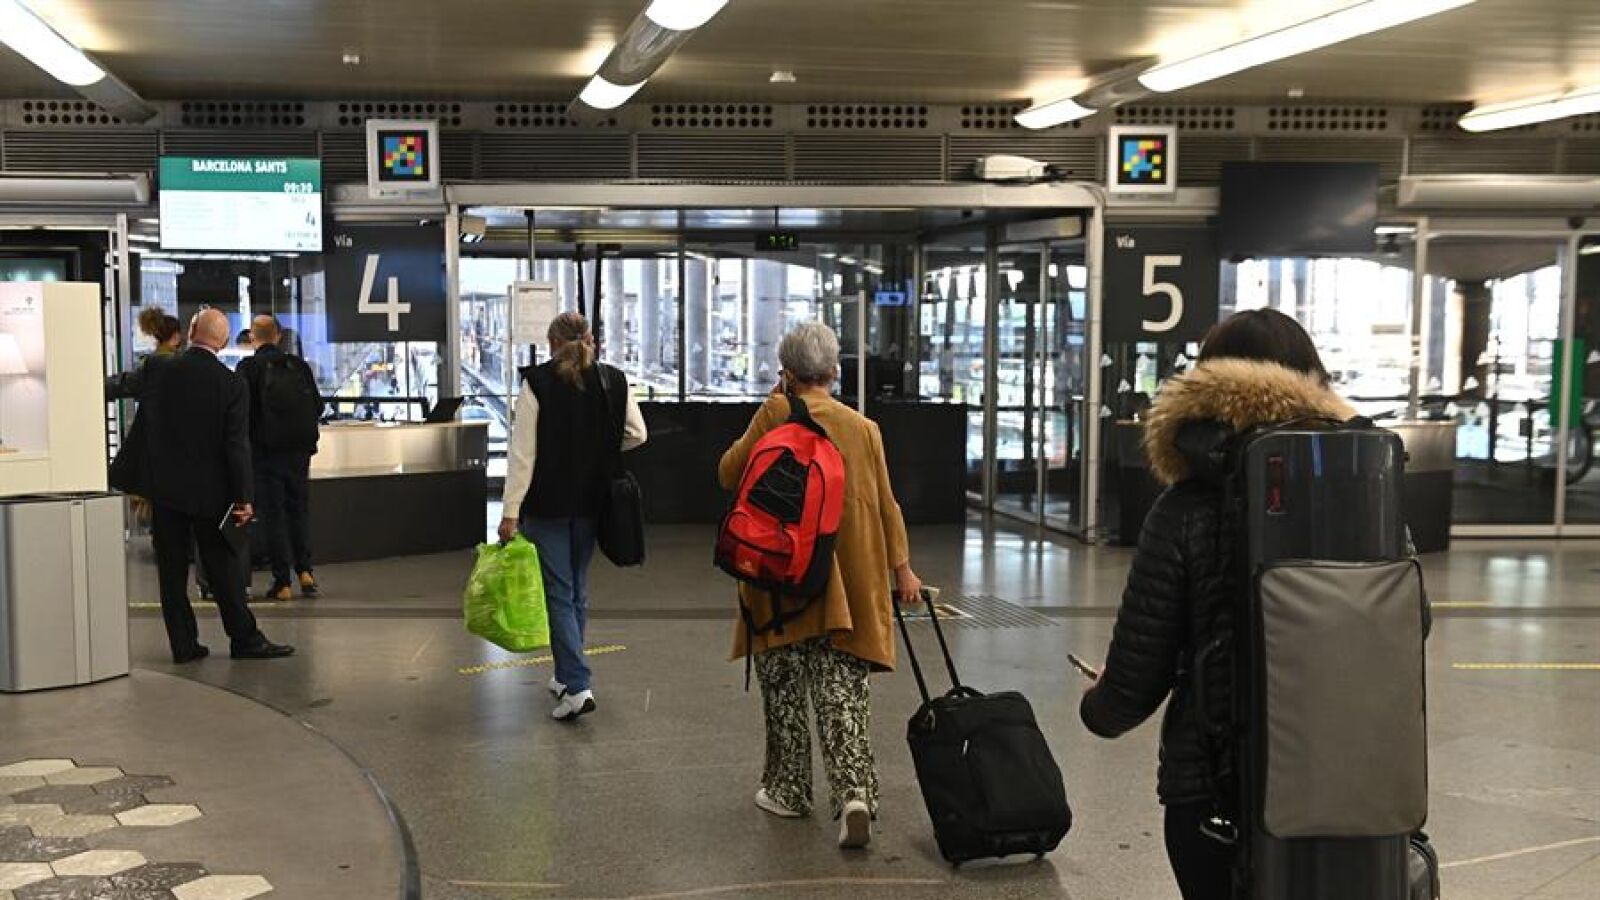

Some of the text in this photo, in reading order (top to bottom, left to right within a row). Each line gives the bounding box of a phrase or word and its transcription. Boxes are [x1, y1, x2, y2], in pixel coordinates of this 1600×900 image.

[192, 160, 288, 174] BARCELONA SANTS
[358, 254, 411, 331] 4
[1141, 255, 1185, 332] 5
